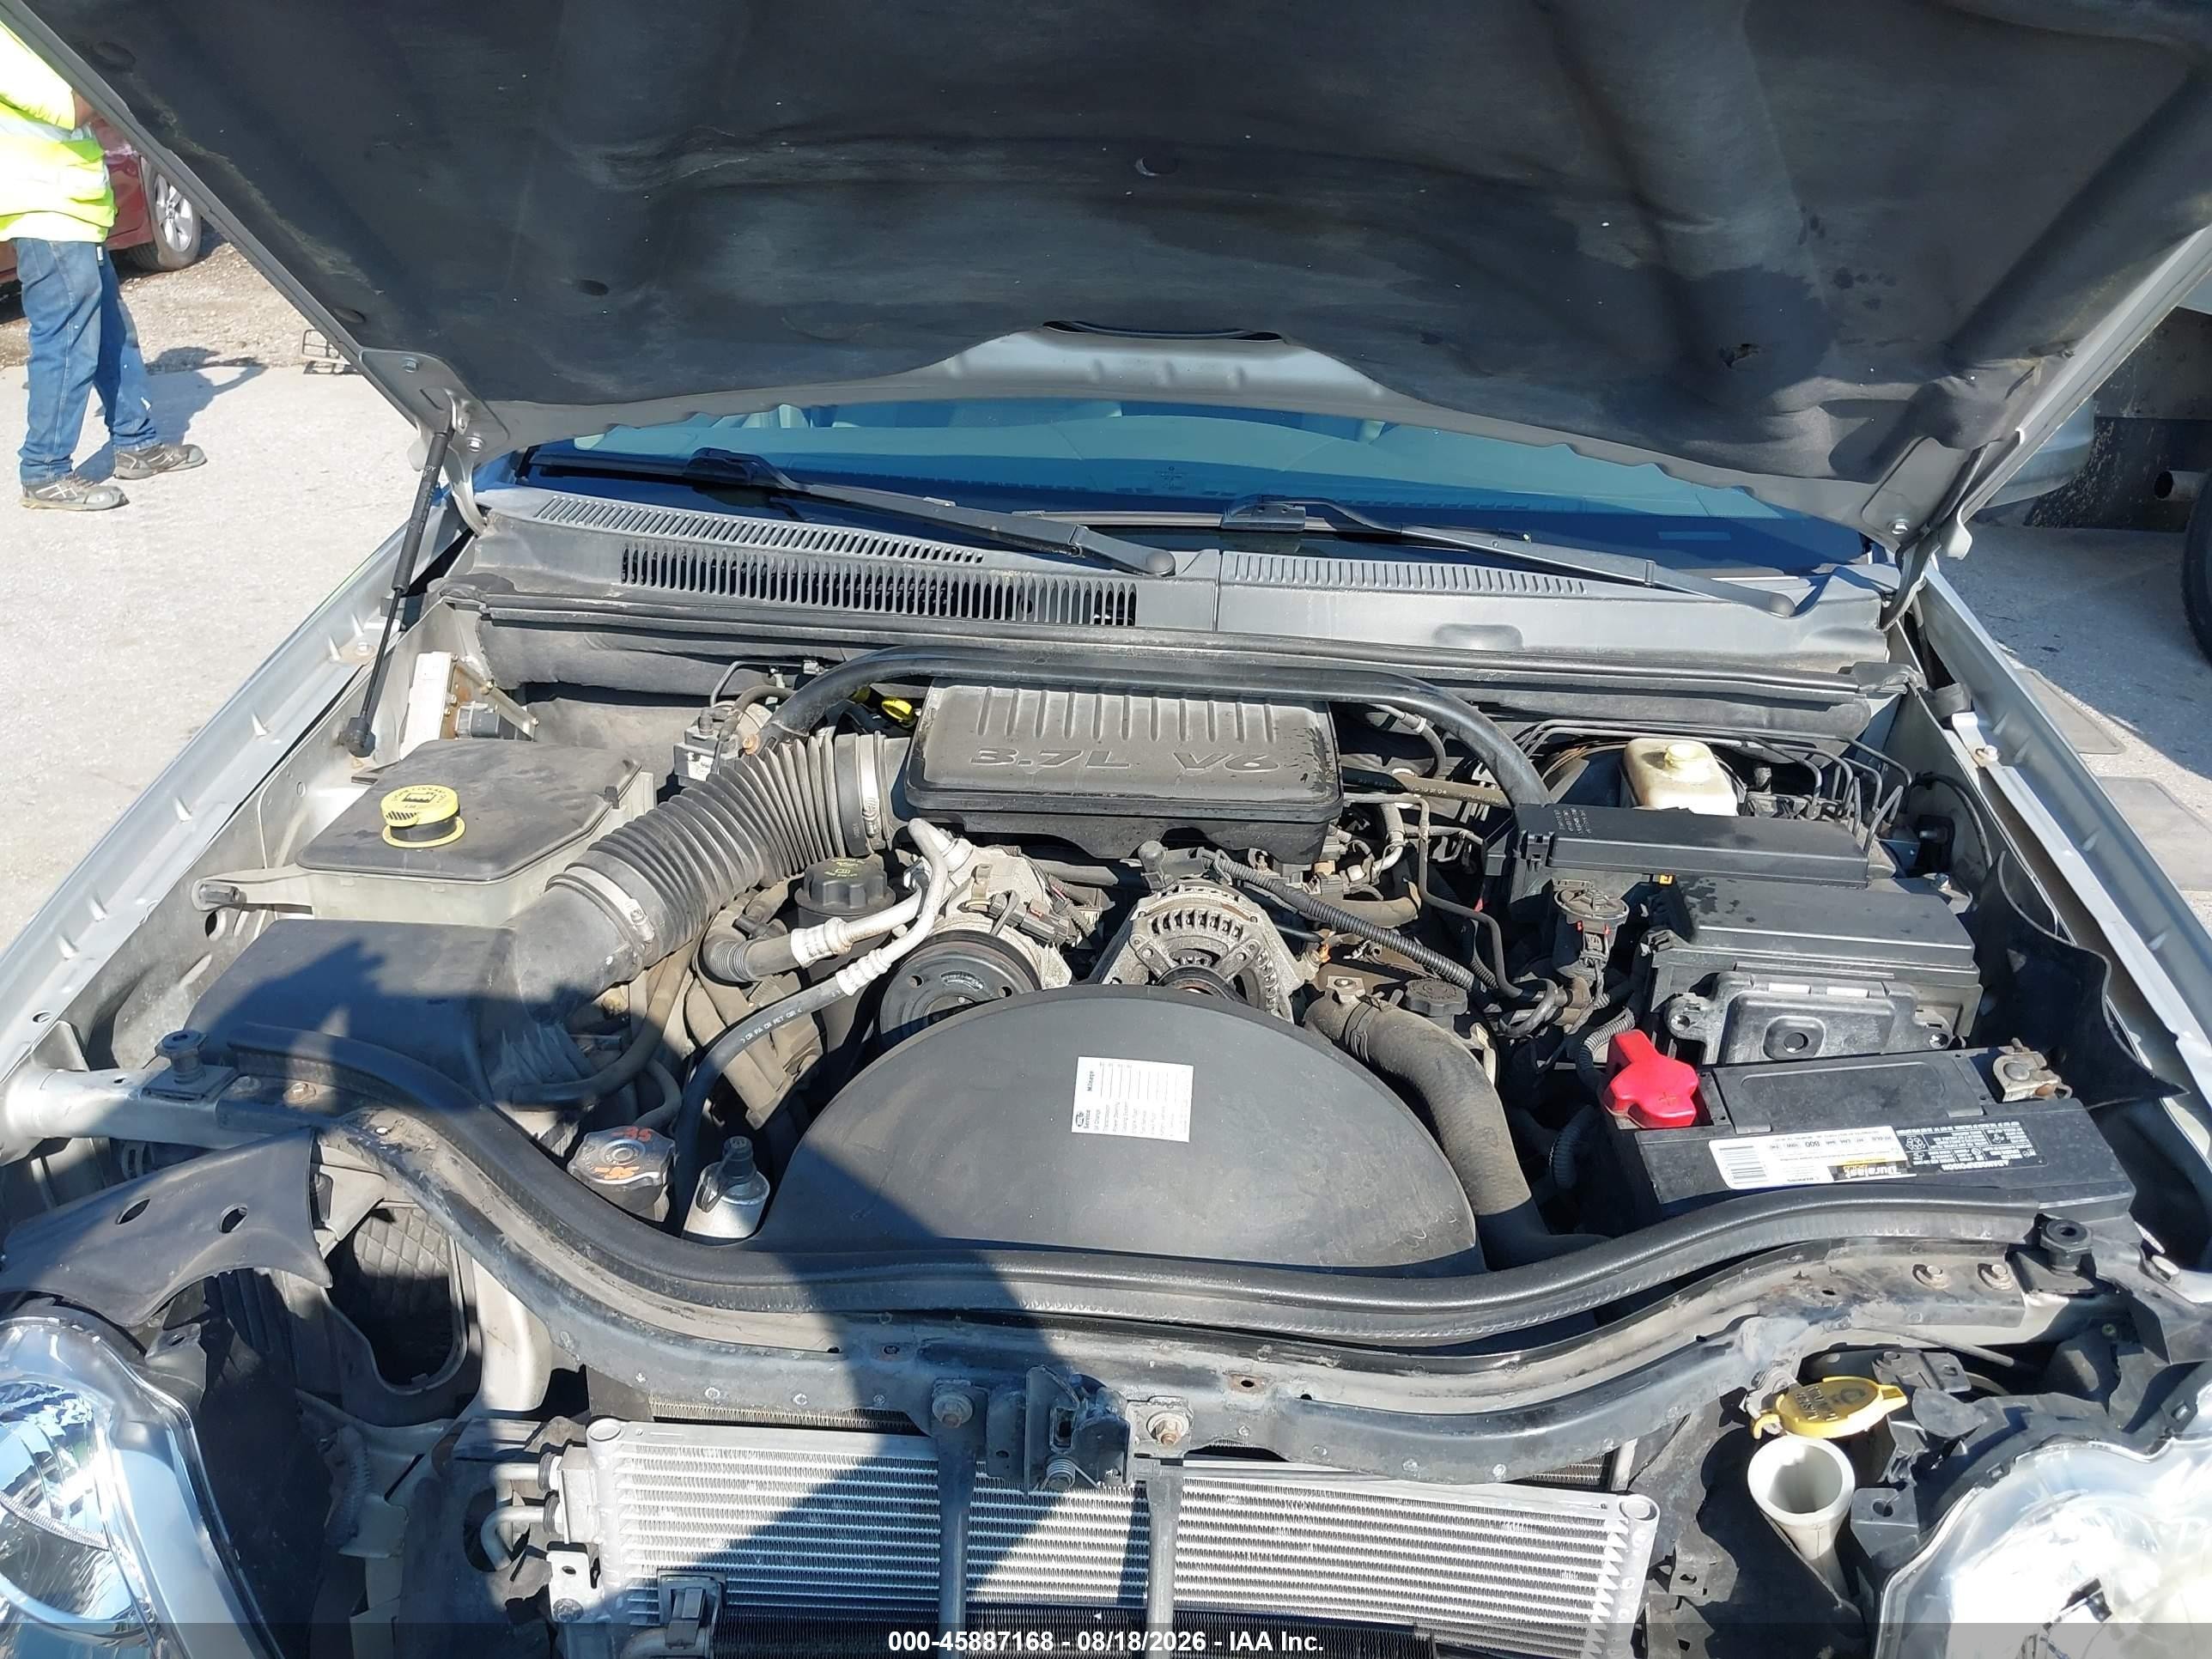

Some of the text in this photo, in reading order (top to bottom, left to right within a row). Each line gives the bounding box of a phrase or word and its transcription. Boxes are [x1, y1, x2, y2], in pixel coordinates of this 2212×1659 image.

[970, 748, 1280, 773] 3.7L V6
[1843, 1164, 1901, 1180] Duralast
